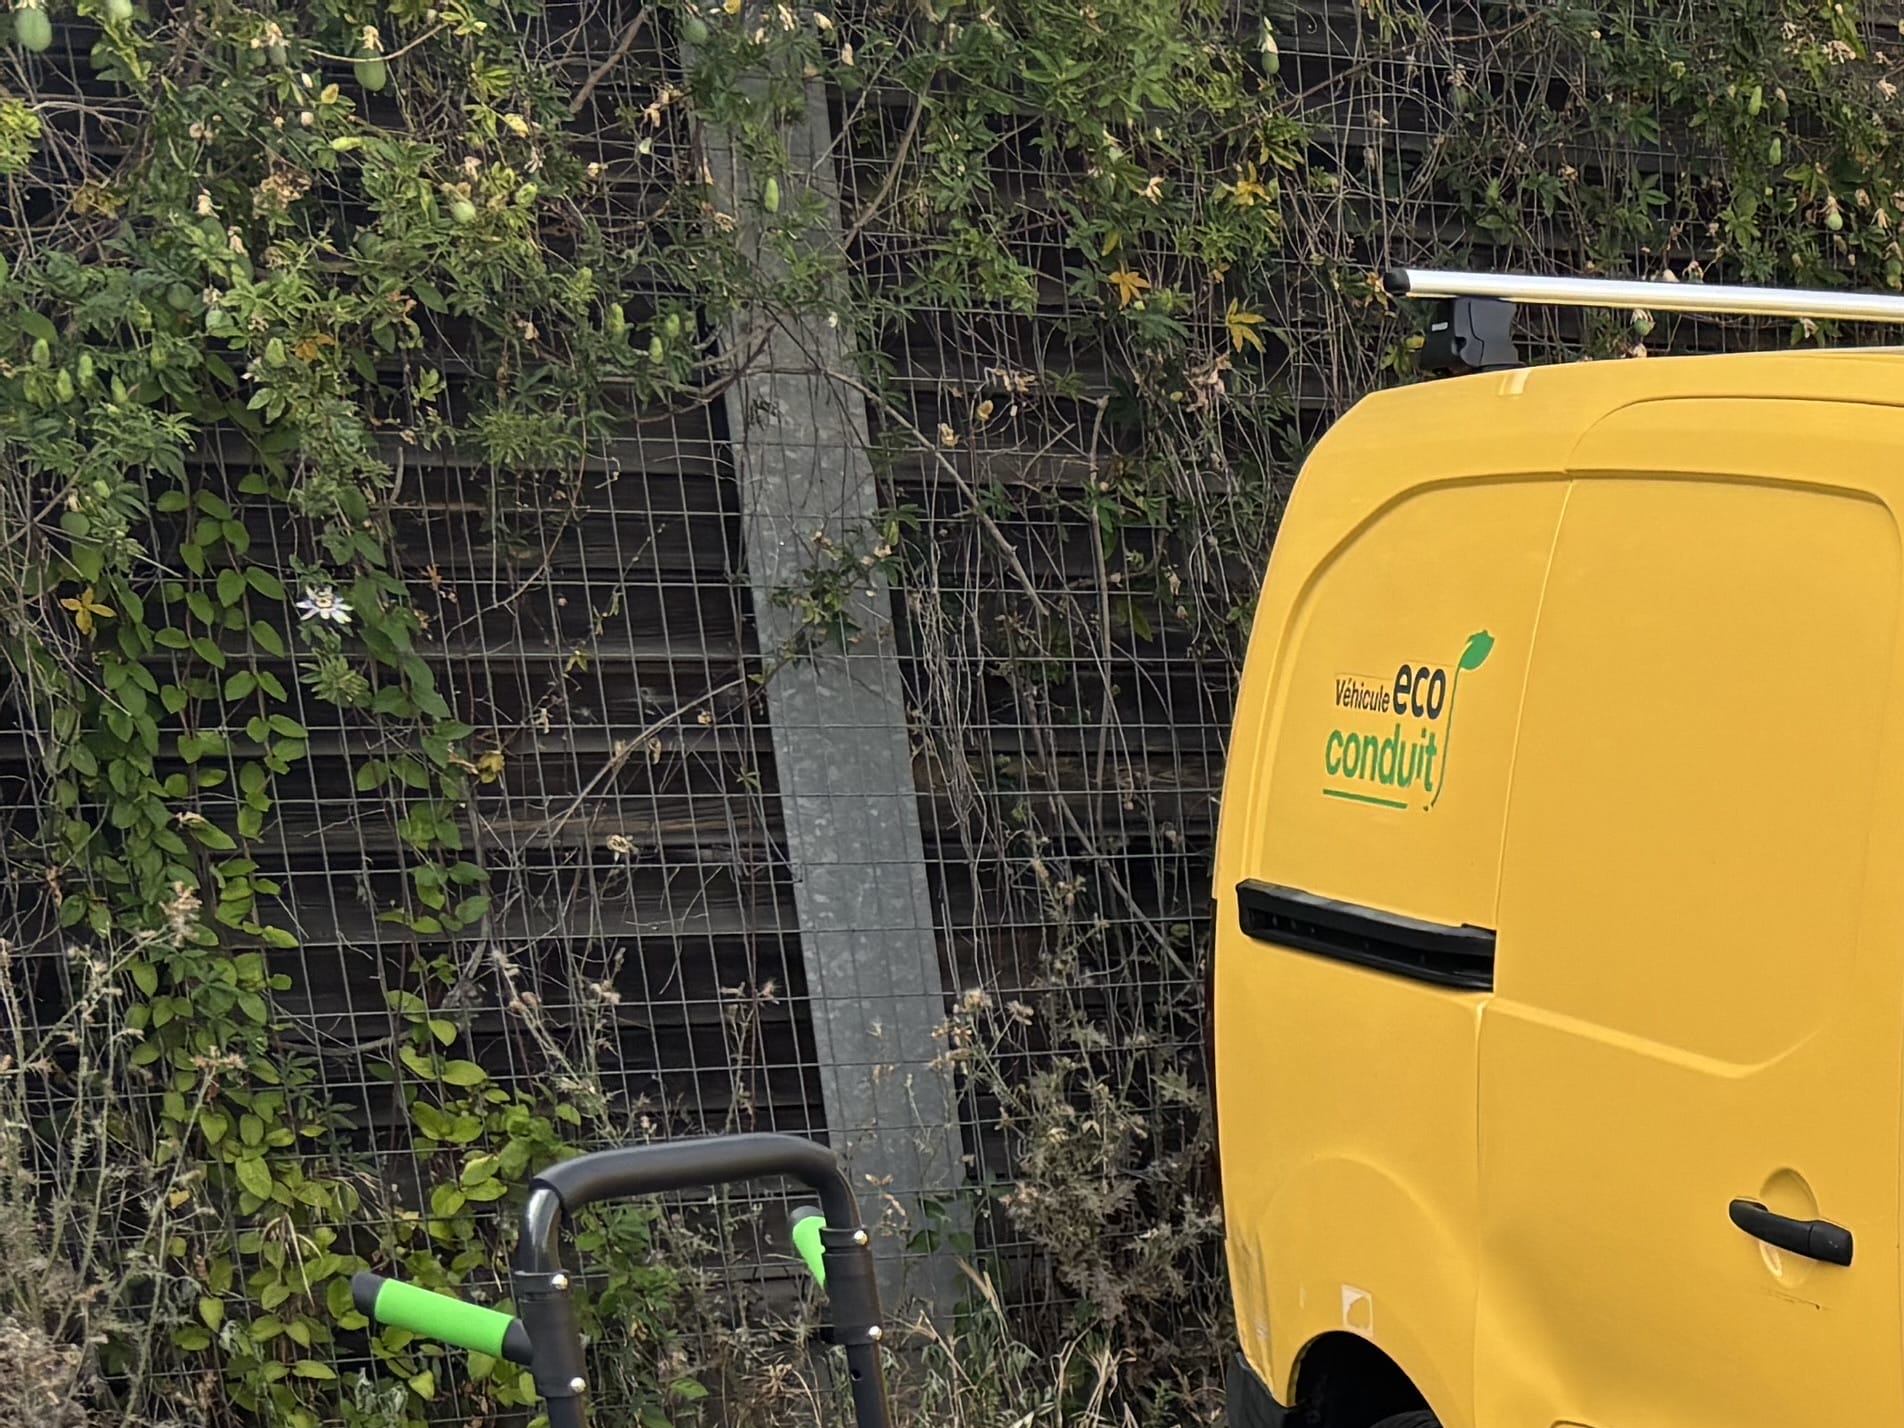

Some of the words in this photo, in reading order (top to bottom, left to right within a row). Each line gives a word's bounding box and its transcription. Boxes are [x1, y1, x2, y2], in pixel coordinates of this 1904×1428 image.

[1335, 677, 1390, 713] Véhicule
[1393, 664, 1447, 720] eco
[1325, 723, 1438, 792] conduit
